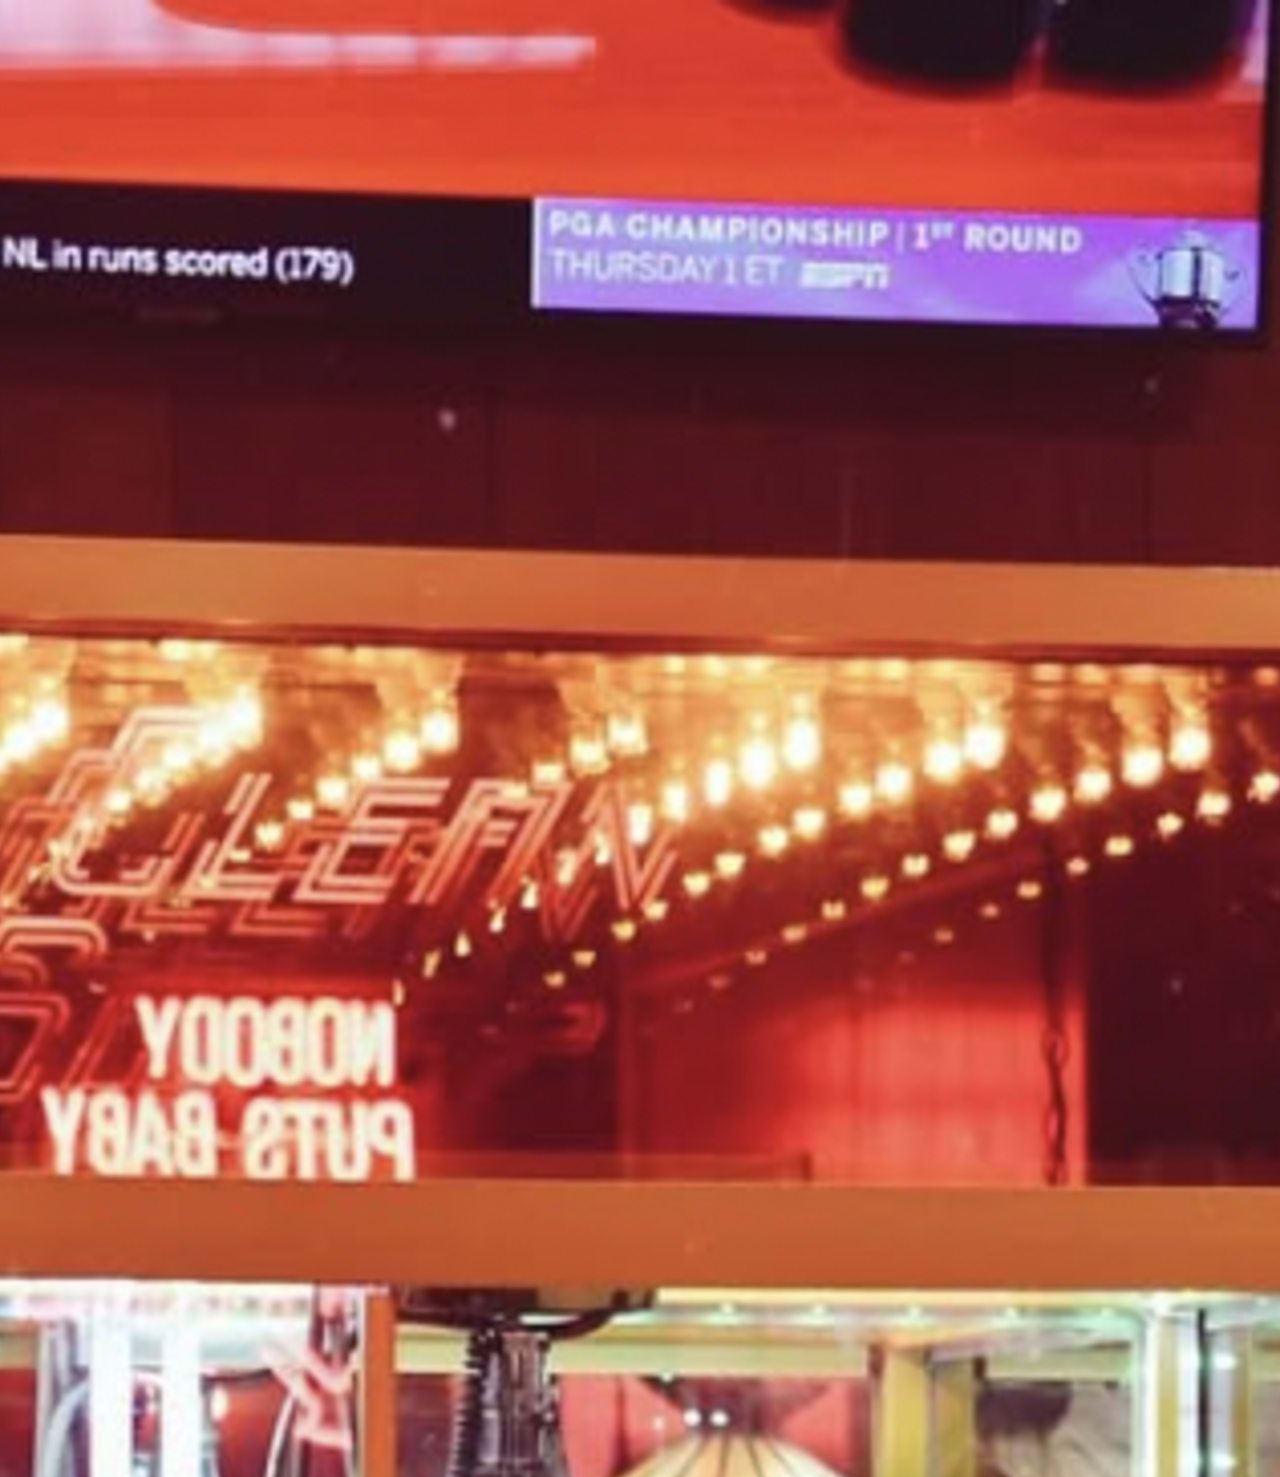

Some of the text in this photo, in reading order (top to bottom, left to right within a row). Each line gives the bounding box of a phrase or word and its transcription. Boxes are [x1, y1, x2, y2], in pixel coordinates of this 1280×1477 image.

[549, 210, 615, 238] PGA
[625, 213, 890, 248] CHAMPIONSHIP
[963, 223, 1083, 255] ROUND
[2, 238, 47, 270] NL
[53, 239, 81, 271] in
[88, 246, 158, 273] runs
[165, 247, 269, 279] scored
[274, 248, 355, 286] (179)
[552, 248, 716, 286] THURSDAY
[746, 255, 786, 287] ET
[800, 261, 890, 290] ESPN
